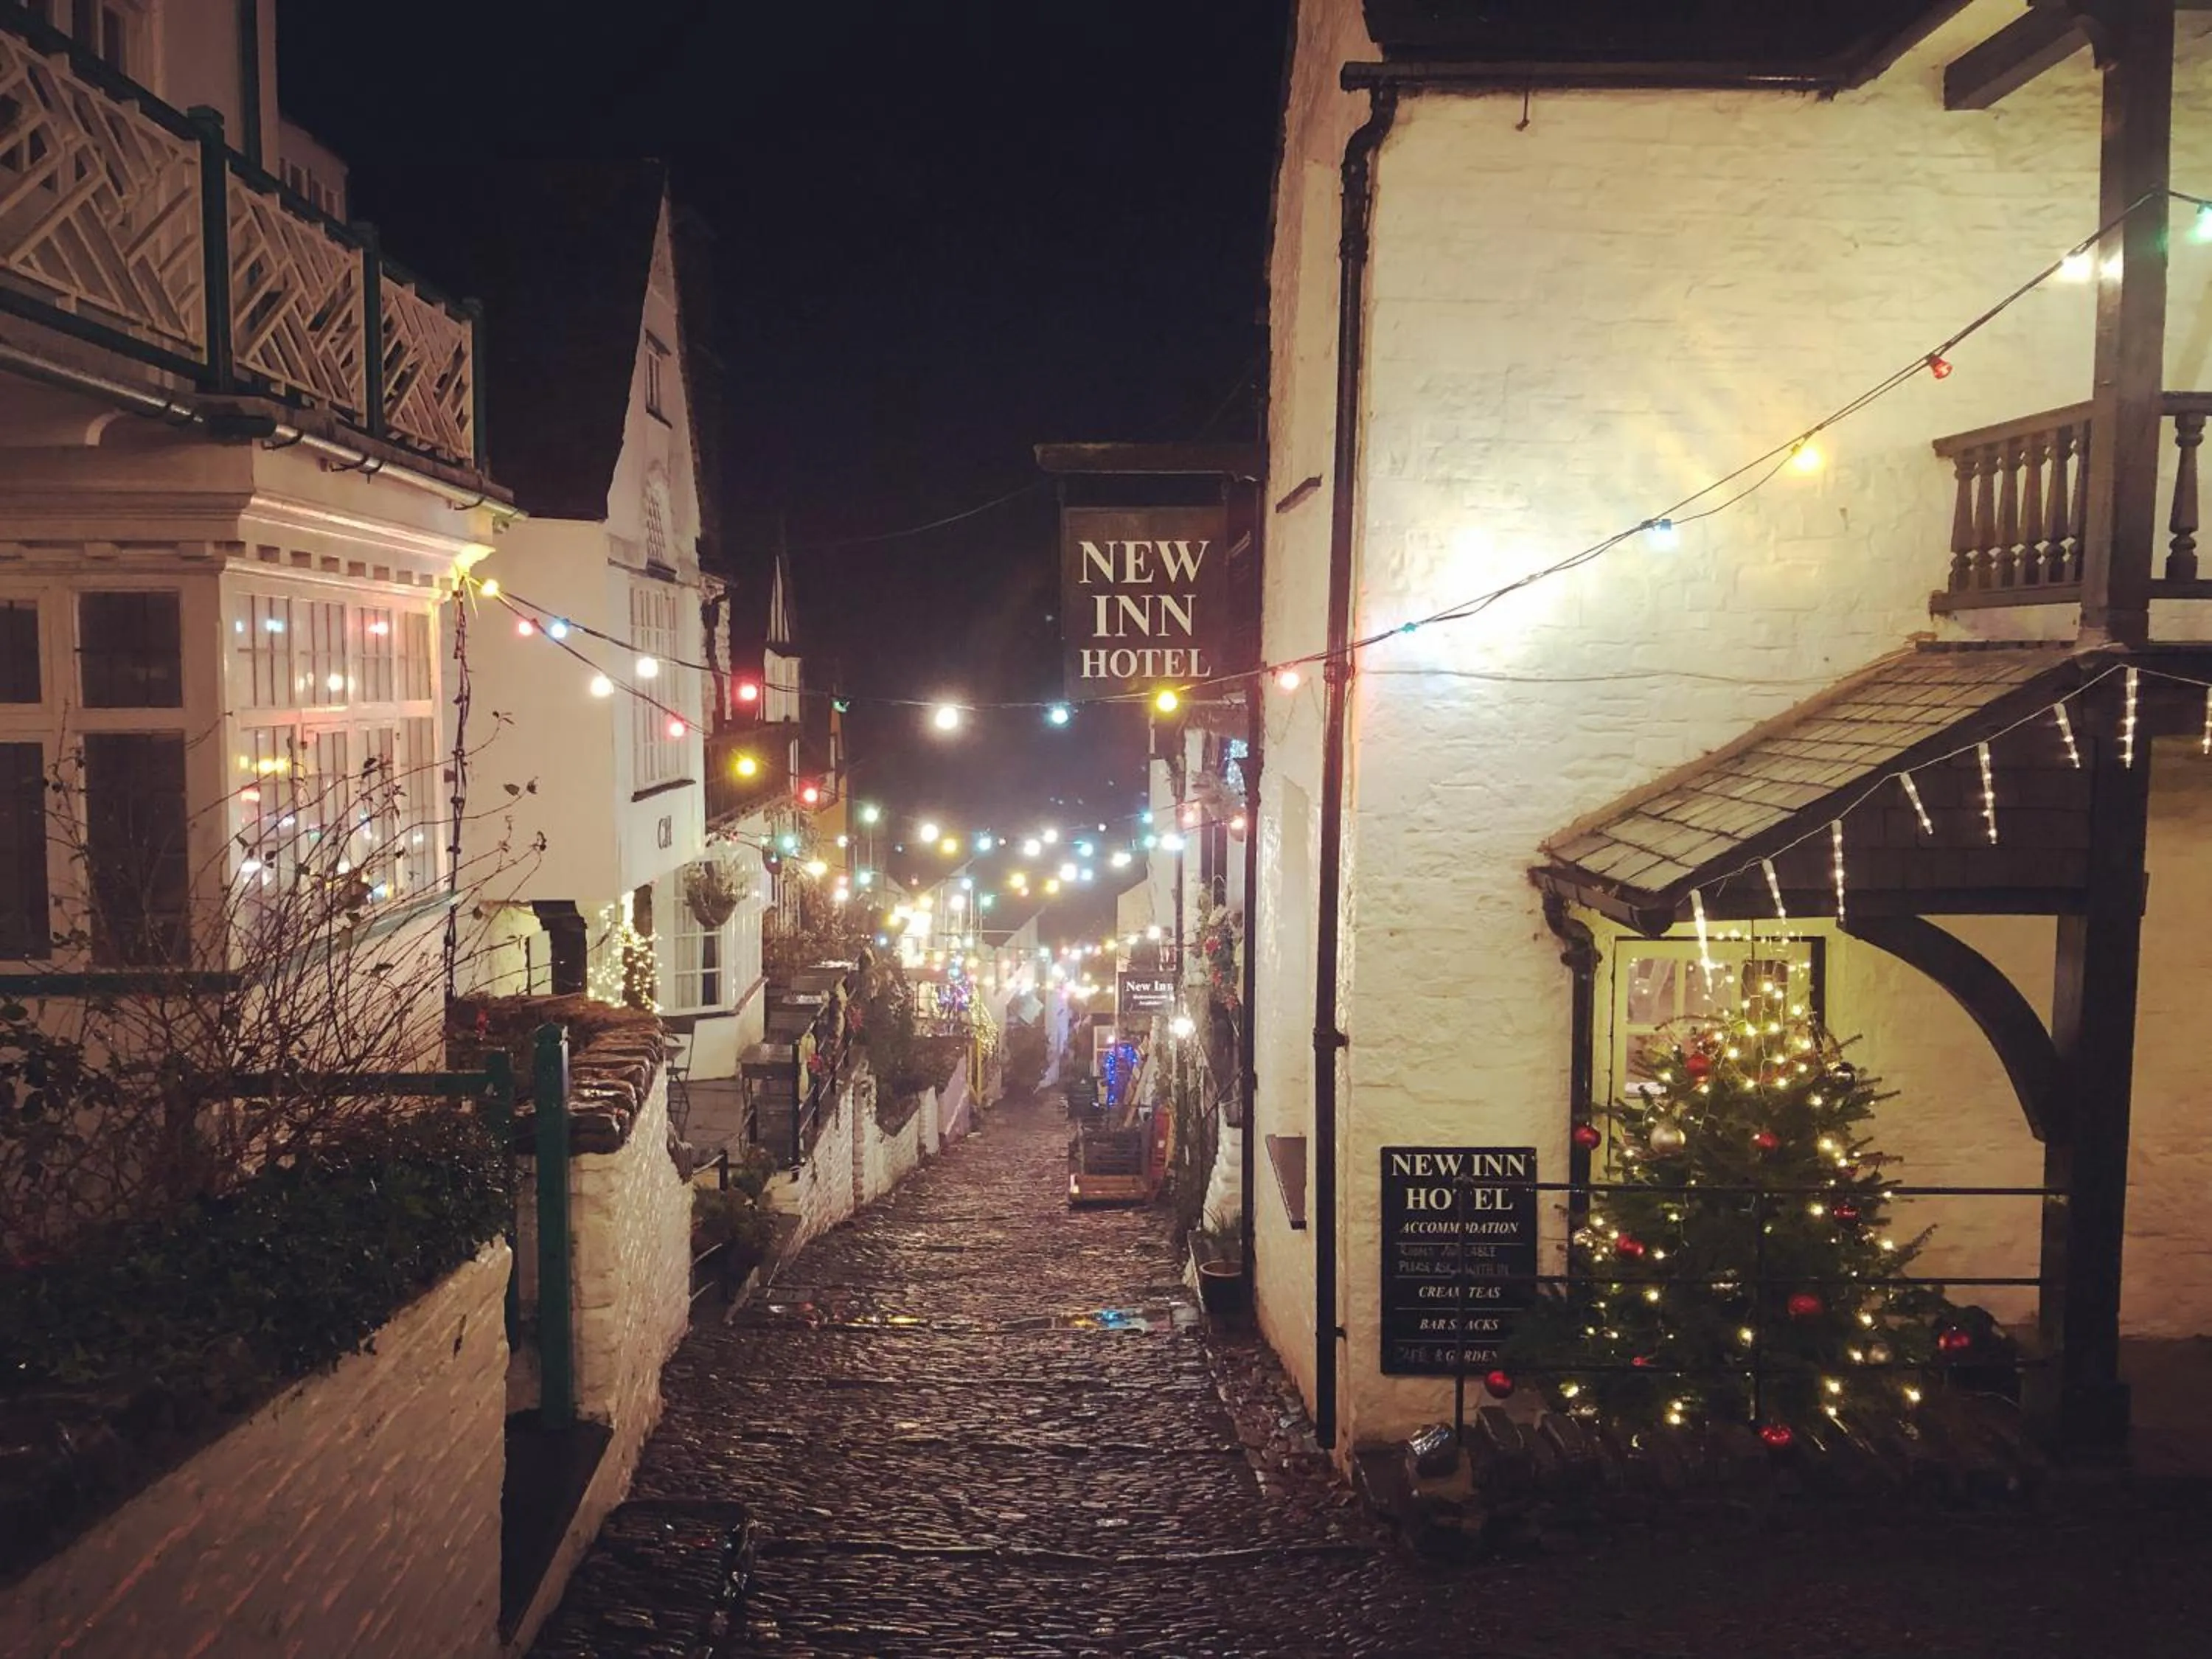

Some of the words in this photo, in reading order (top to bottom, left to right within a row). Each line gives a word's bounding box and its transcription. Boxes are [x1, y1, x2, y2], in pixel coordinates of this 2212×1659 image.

[1078, 540, 1210, 583] NEW
[1091, 594, 1197, 637] INN
[1079, 648, 1211, 678] HOTEL
[1126, 981, 1151, 992] New
[1154, 980, 1174, 992] Inn
[1391, 1153, 1463, 1177] NEW
[1472, 1153, 1526, 1177] INN
[1405, 1188, 1514, 1210] HOEL
[1468, 1286, 1502, 1298] TEAS
[1447, 1318, 1499, 1331] SACKS
[1445, 1349, 1498, 1362] GRDEN
